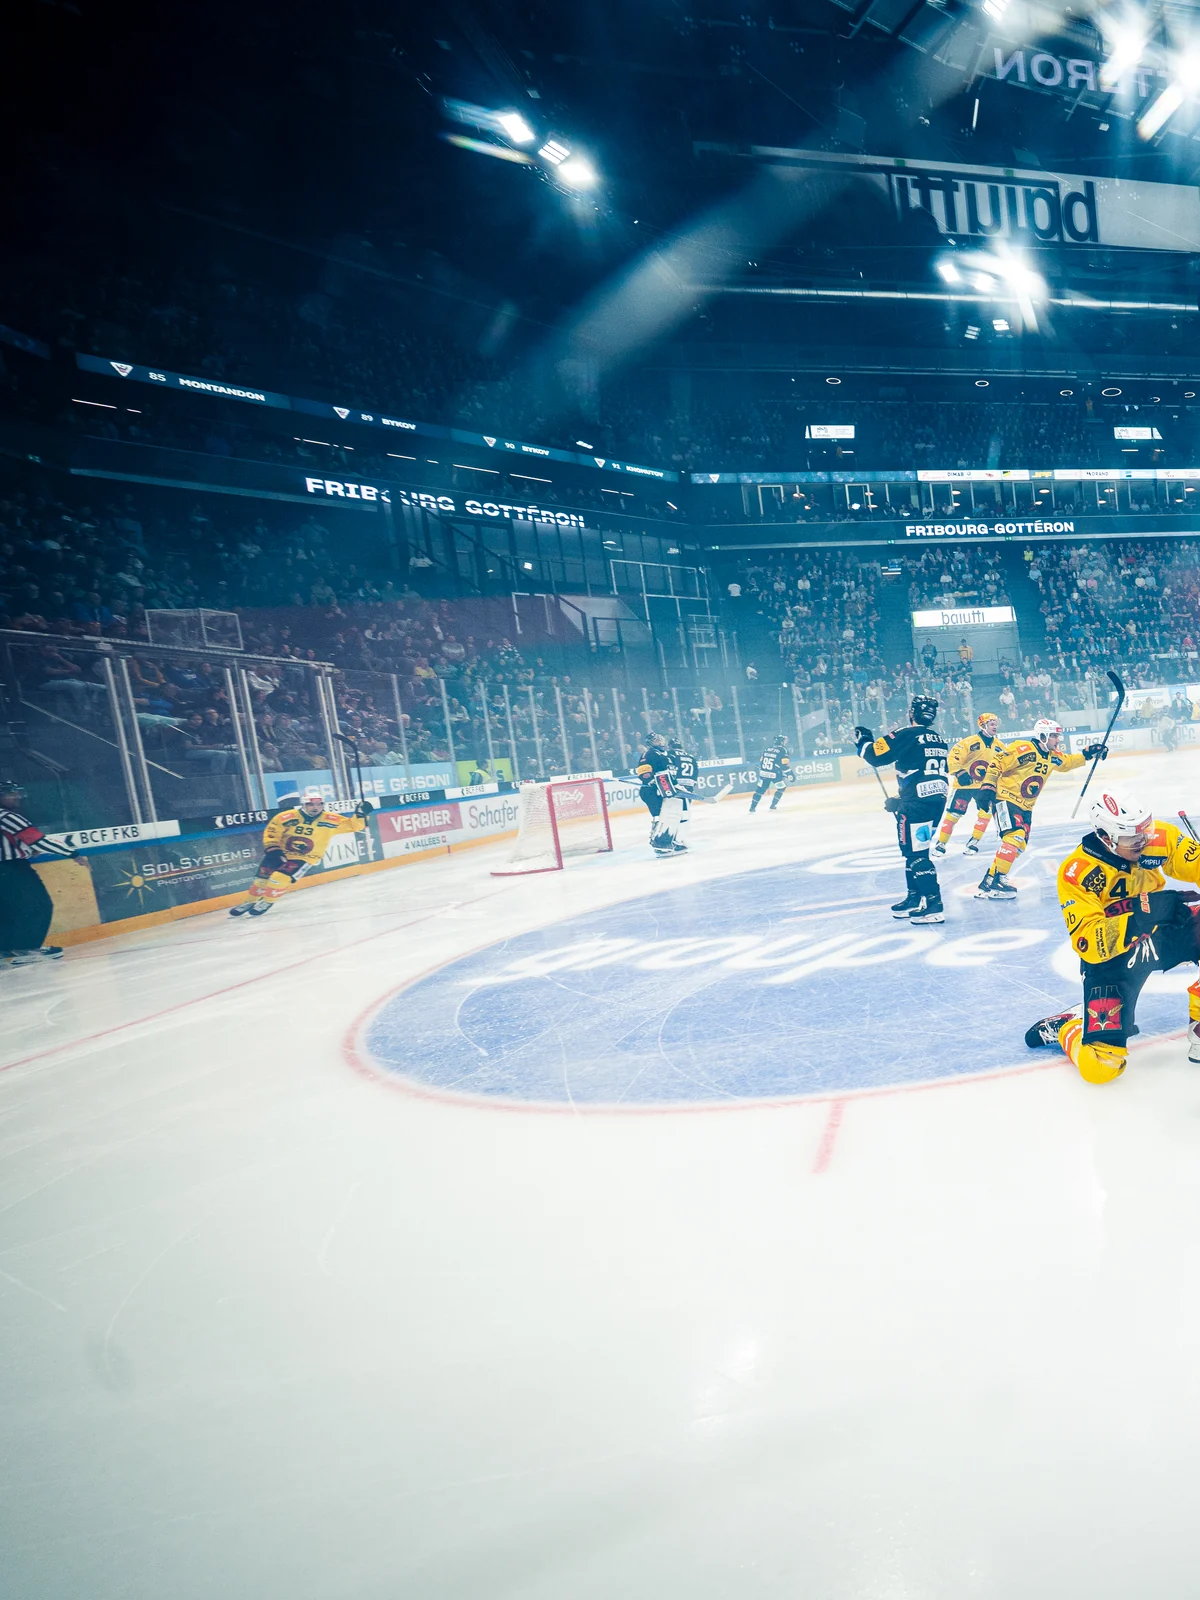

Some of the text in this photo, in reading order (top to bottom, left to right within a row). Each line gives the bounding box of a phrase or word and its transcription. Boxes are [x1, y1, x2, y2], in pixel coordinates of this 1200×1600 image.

[149, 371, 266, 402] 85 MONTANDON
[361, 412, 416, 431] 89 BYKOV
[504, 442, 550, 456] 90 BYKOV
[465, 499, 586, 528] GOTTÉRON
[905, 519, 1075, 537] FRIBOURG-GOTTÉRON
[941, 610, 985, 624] baiutti
[681, 762, 694, 776] 27
[762, 757, 773, 770] 95
[795, 760, 833, 775] celsa
[1034, 762, 1048, 775] 23
[697, 770, 757, 790] BCF FKB
[405, 791, 429, 802] BCF FKB
[605, 786, 640, 807] group
[225, 810, 268, 828] BCF FKB
[390, 809, 452, 833] VERBIER
[80, 825, 140, 845] BCF FKB
[294, 825, 314, 836] 83
[404, 835, 441, 850] 4 VALLÉES
[1109, 877, 1129, 899] 4
